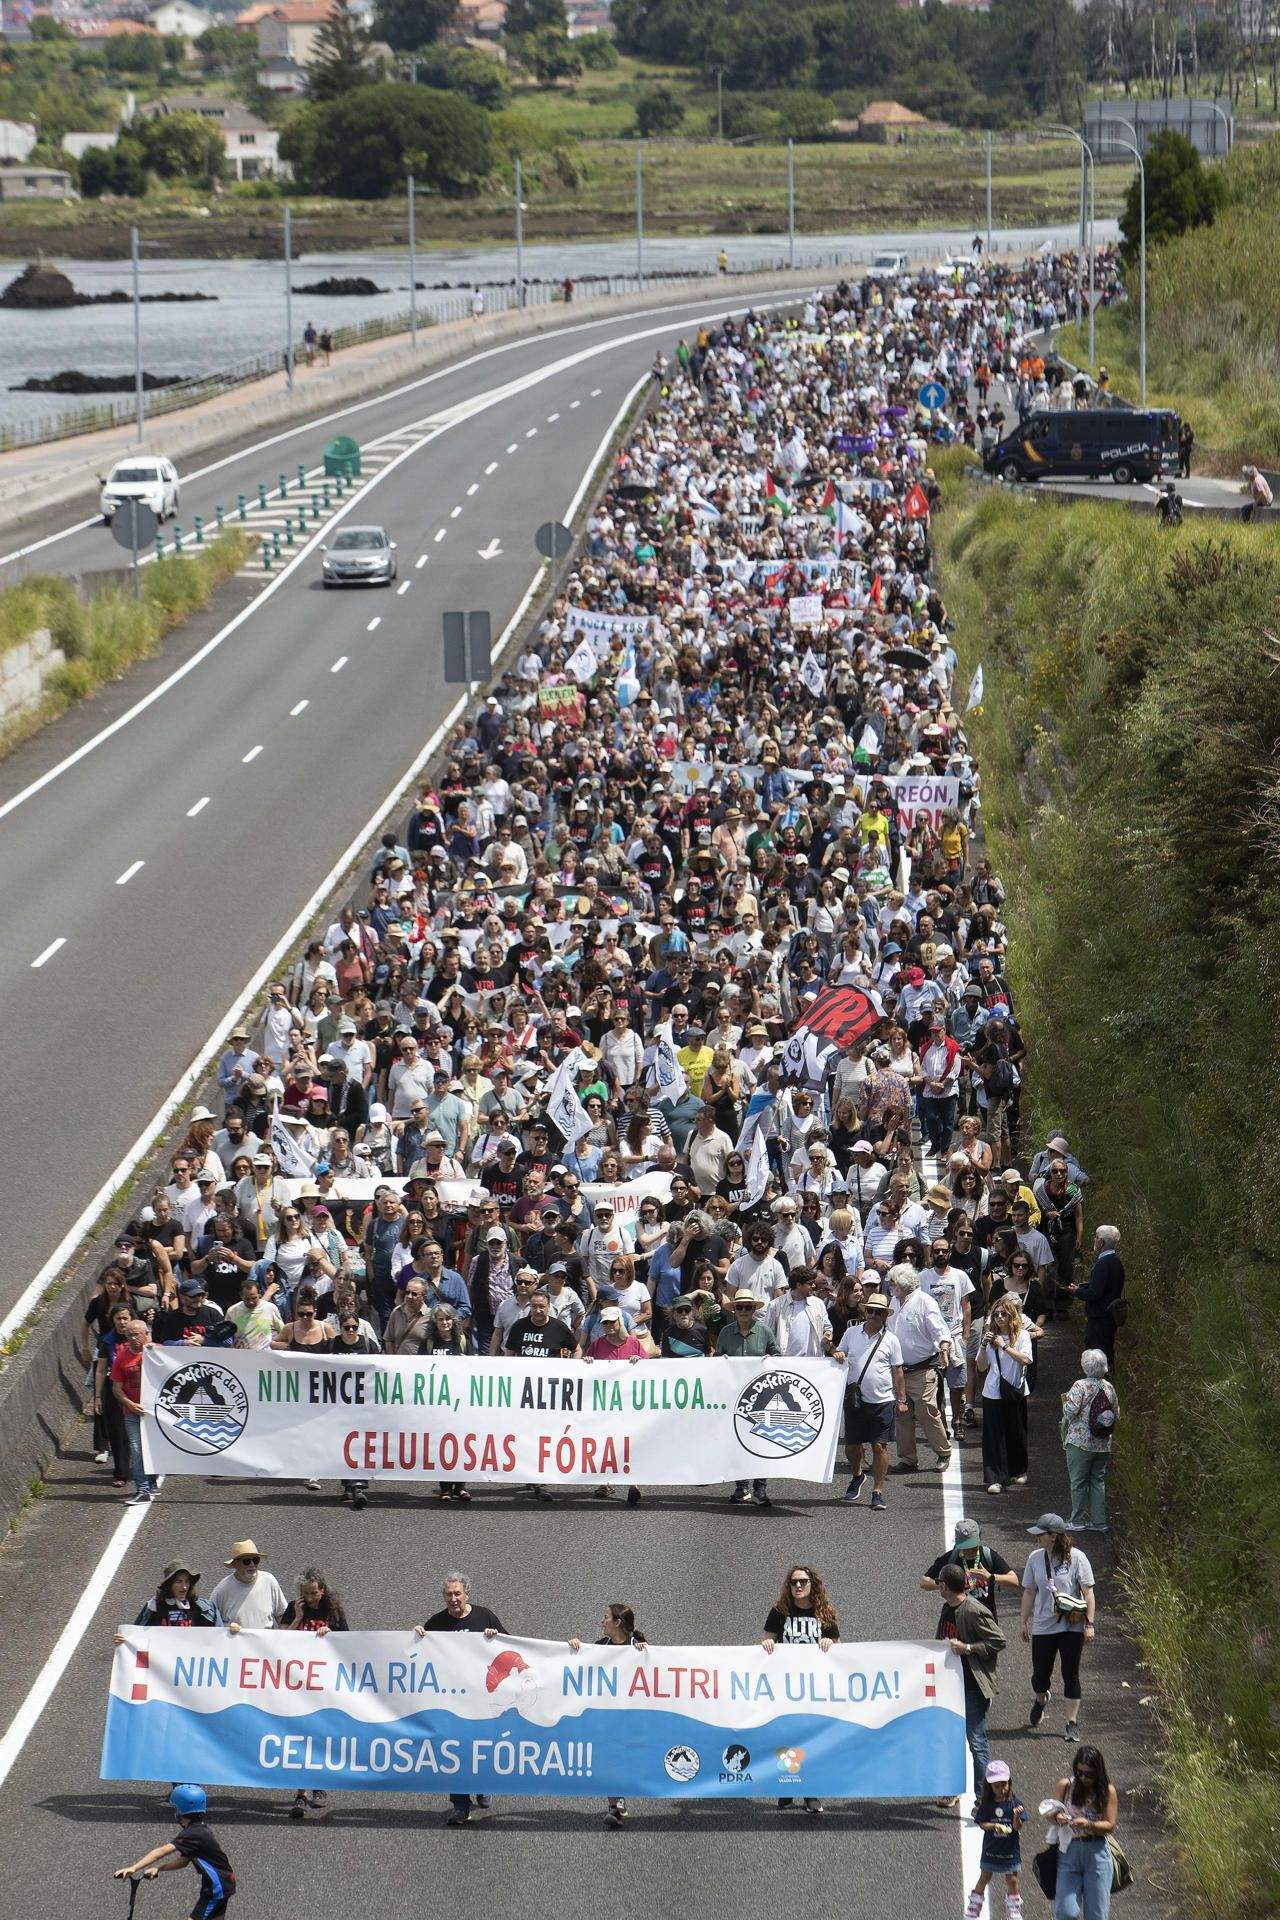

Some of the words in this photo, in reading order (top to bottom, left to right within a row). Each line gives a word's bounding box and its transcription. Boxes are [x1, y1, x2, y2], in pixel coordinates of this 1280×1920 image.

[1100, 443, 1149, 461] POLICIA
[729, 1190, 745, 1203] ALT
[523, 1333, 543, 1343] ENCE
[174, 1366, 223, 1386] Defensa
[223, 1378, 237, 1393] da
[258, 1370, 299, 1402] NIN
[309, 1371, 364, 1405] ENCE
[374, 1371, 401, 1405] NA
[413, 1364, 460, 1412] RÍA,
[470, 1375, 511, 1408] NIN
[520, 1377, 582, 1411] ALTRI
[593, 1380, 623, 1412] NA
[633, 1377, 727, 1411] ULLOA...
[752, 1374, 801, 1393] Defensa
[800, 1386, 813, 1400] da
[343, 1430, 516, 1473] CELULOSAS
[538, 1425, 631, 1474] FÓRA!
[783, 1617, 822, 1638] ALTRI
[173, 1656, 229, 1687] NIN
[239, 1658, 327, 1690] ENCE
[336, 1662, 379, 1694] NA
[388, 1653, 467, 1695] RÍA...
[562, 1665, 618, 1697] NIN
[628, 1666, 718, 1700] ALTRI
[731, 1671, 775, 1702] NA
[785, 1670, 900, 1703] ULLOA!
[259, 1734, 461, 1775] CELULOSAS
[472, 1731, 593, 1776] FÓRA!!!
[719, 1773, 752, 1783] PDRA
